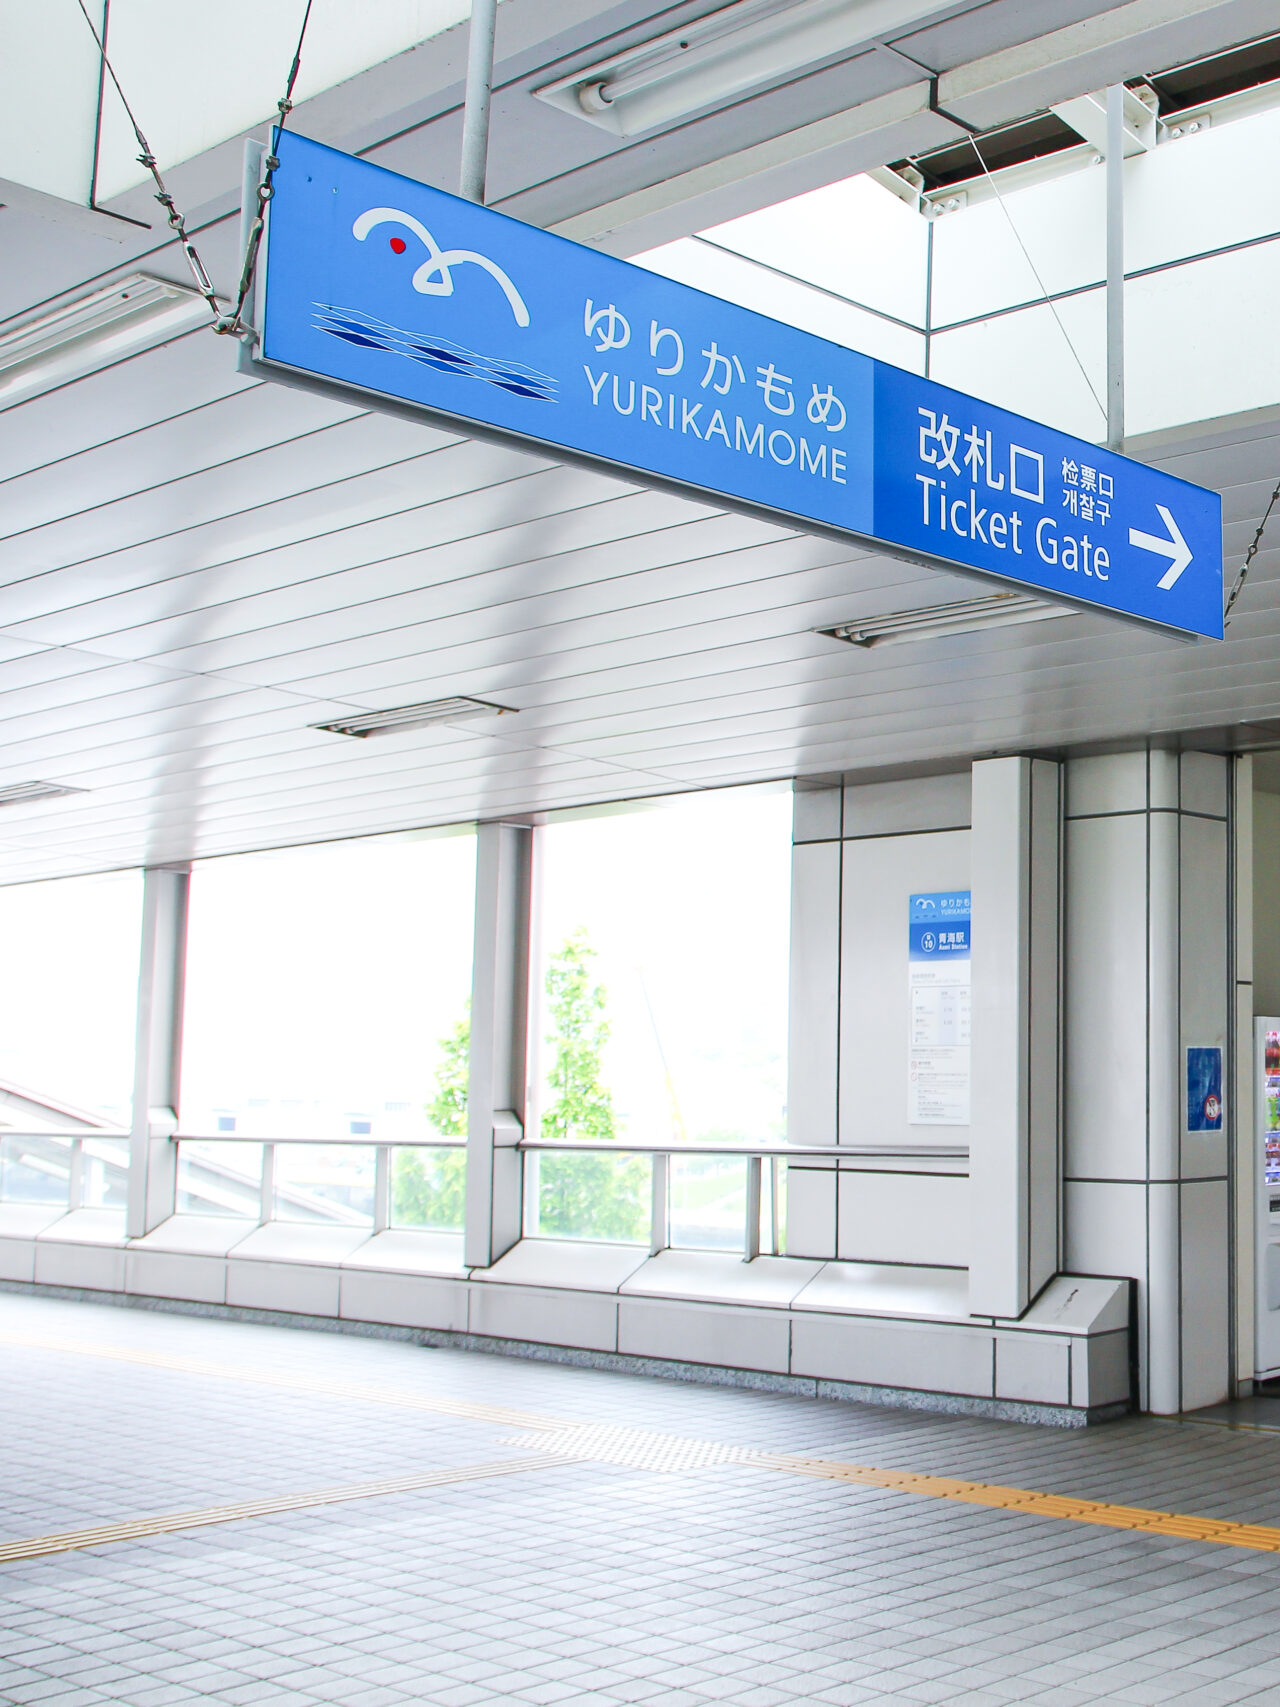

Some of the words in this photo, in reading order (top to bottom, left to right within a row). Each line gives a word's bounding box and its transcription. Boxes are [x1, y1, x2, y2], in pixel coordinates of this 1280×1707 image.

[583, 299, 847, 433] ゆりかもめ
[583, 365, 847, 484] YURIKAMOME
[918, 407, 1044, 504] 改札口
[1062, 457, 1114, 499] 检票口
[1062, 488, 1111, 526] 개찰구
[916, 474, 1023, 555] Ticket
[1036, 517, 1109, 581] Gate
[925, 940, 933, 948] 10
[939, 932, 965, 944] 青海駅
